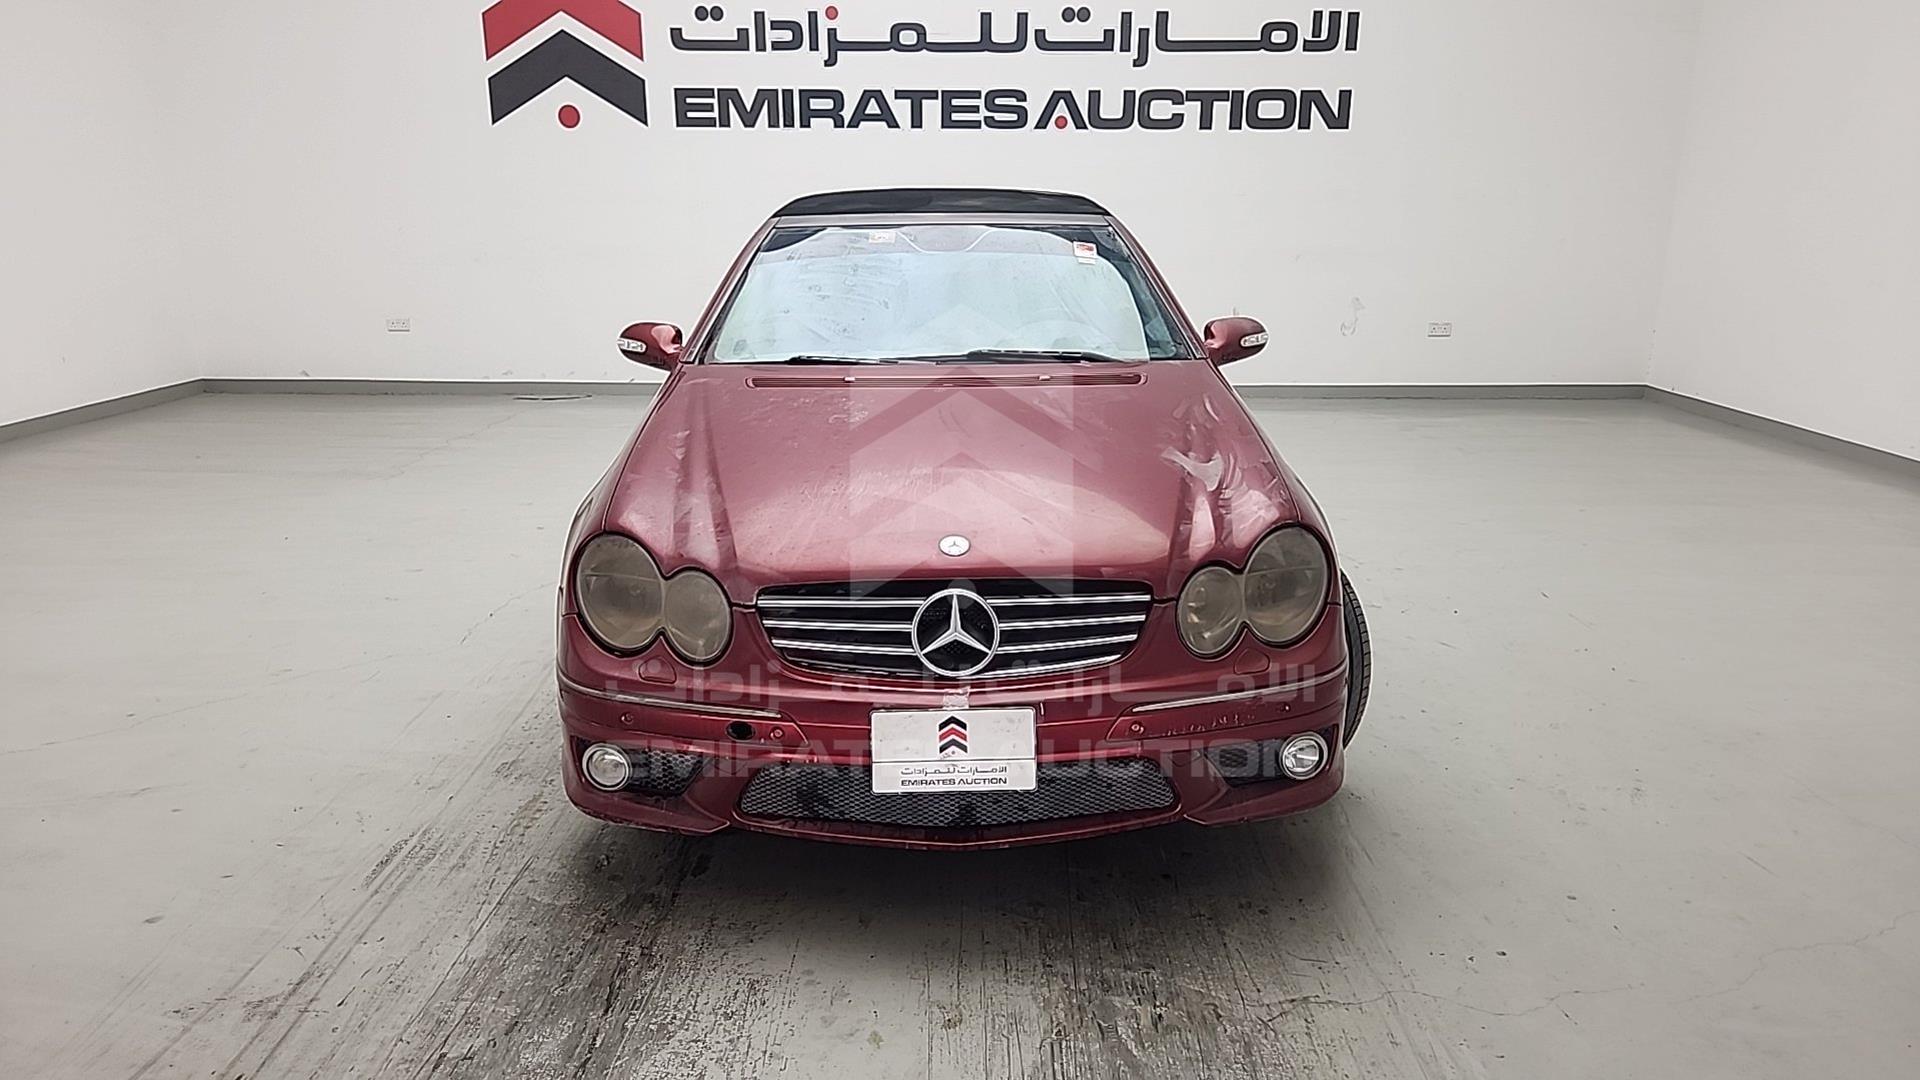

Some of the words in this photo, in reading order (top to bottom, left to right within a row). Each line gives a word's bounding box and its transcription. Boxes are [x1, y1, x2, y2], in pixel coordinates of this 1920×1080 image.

[669, 5, 1029, 68] للمزادات
[1034, 6, 1361, 68] الامارات
[673, 87, 1028, 130] EMIRATES
[1033, 88, 1353, 131] AUCTION
[900, 778, 956, 787] EMIRATES
[957, 777, 1008, 786] AUCTION
